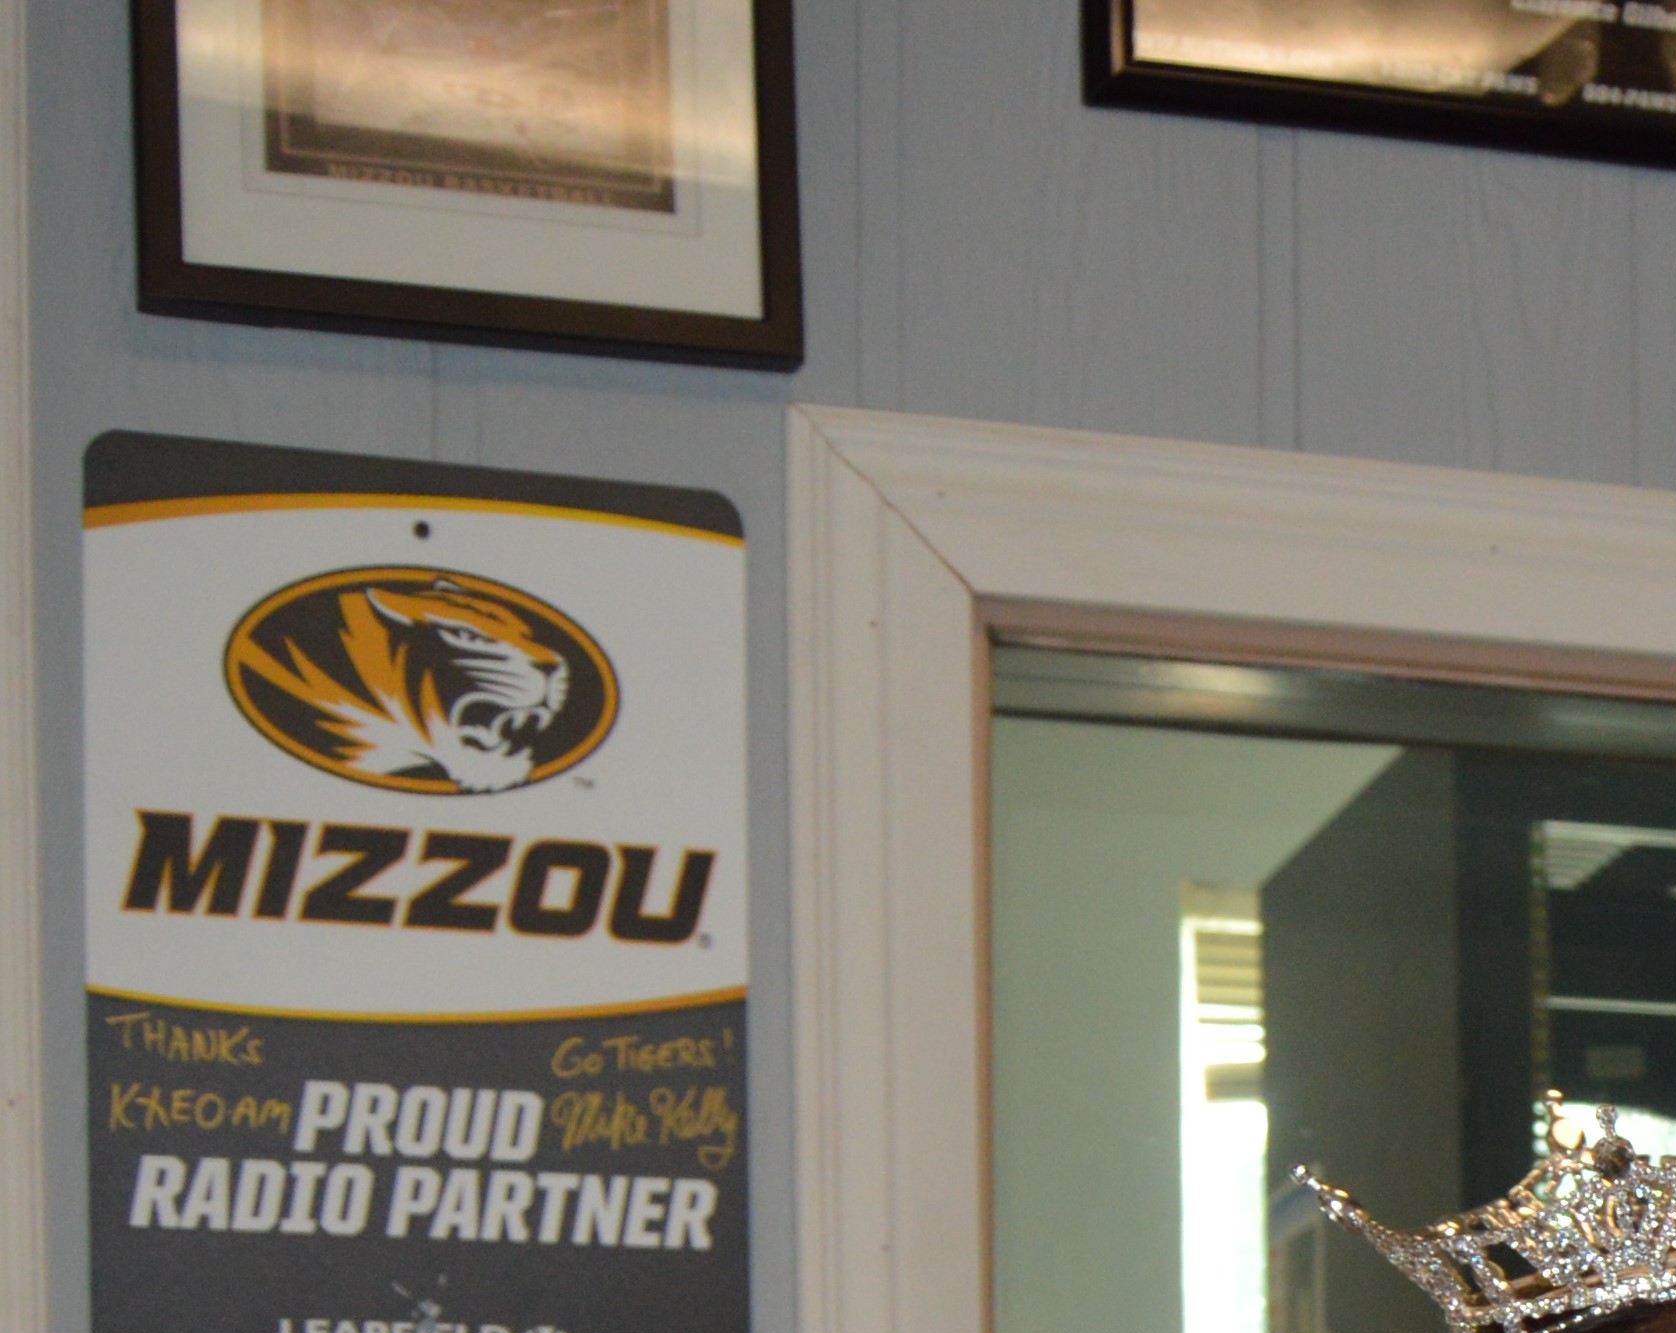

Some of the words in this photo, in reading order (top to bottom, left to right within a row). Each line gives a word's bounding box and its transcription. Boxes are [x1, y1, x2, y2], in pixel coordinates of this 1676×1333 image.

[121, 807, 718, 945] MIZZOU
[104, 1010, 266, 1066] THANKS
[293, 1079, 546, 1164] PROUD
[128, 1153, 377, 1237] RADIO
[384, 1165, 719, 1251] PARTNER
